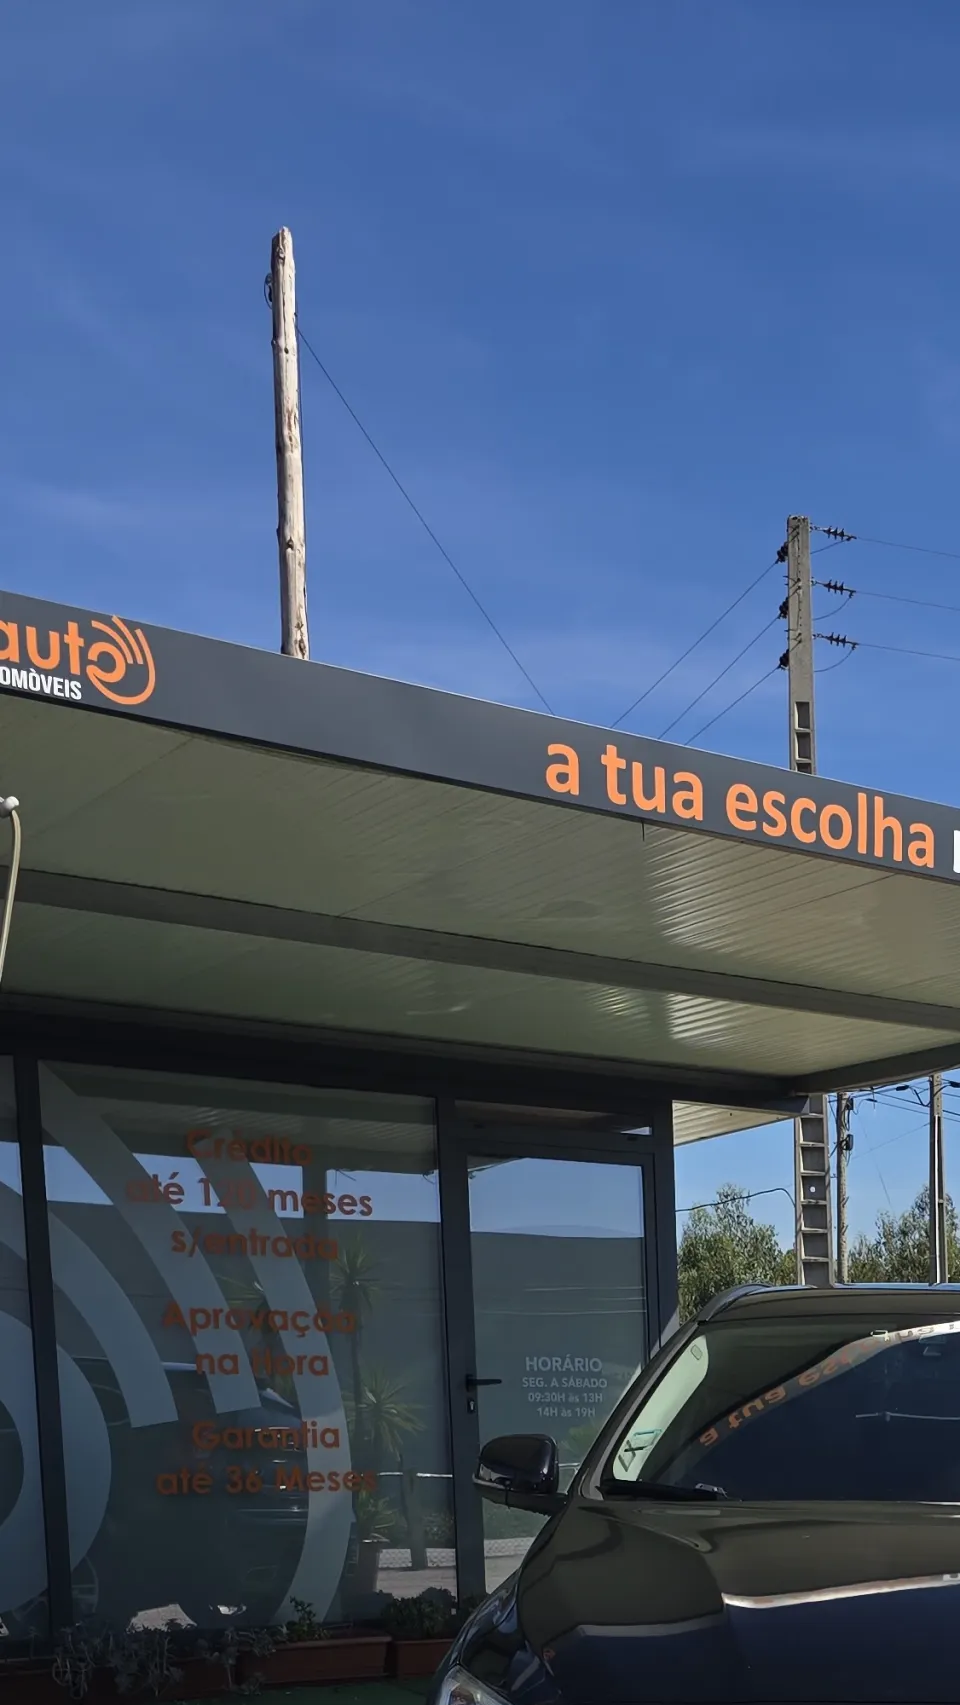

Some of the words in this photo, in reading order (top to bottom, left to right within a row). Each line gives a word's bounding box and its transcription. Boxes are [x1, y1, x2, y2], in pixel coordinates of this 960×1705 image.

[546, 743, 580, 796] a
[601, 744, 704, 821] tua
[726, 783, 935, 869] escolha
[125, 1172, 185, 1205] até
[268, 1189, 373, 1217] meses
[171, 1227, 339, 1260] s/entrada
[195, 1352, 240, 1376] na
[251, 1349, 330, 1377] Hora
[525, 1354, 603, 1372] HORÁRIO
[522, 1377, 548, 1388] SEG.
[551, 1378, 559, 1388] A
[562, 1376, 608, 1388] SÁBADO
[192, 1419, 341, 1450] Garantia
[155, 1461, 213, 1494] até
[225, 1466, 264, 1494] 36
[275, 1466, 377, 1493] Meses
